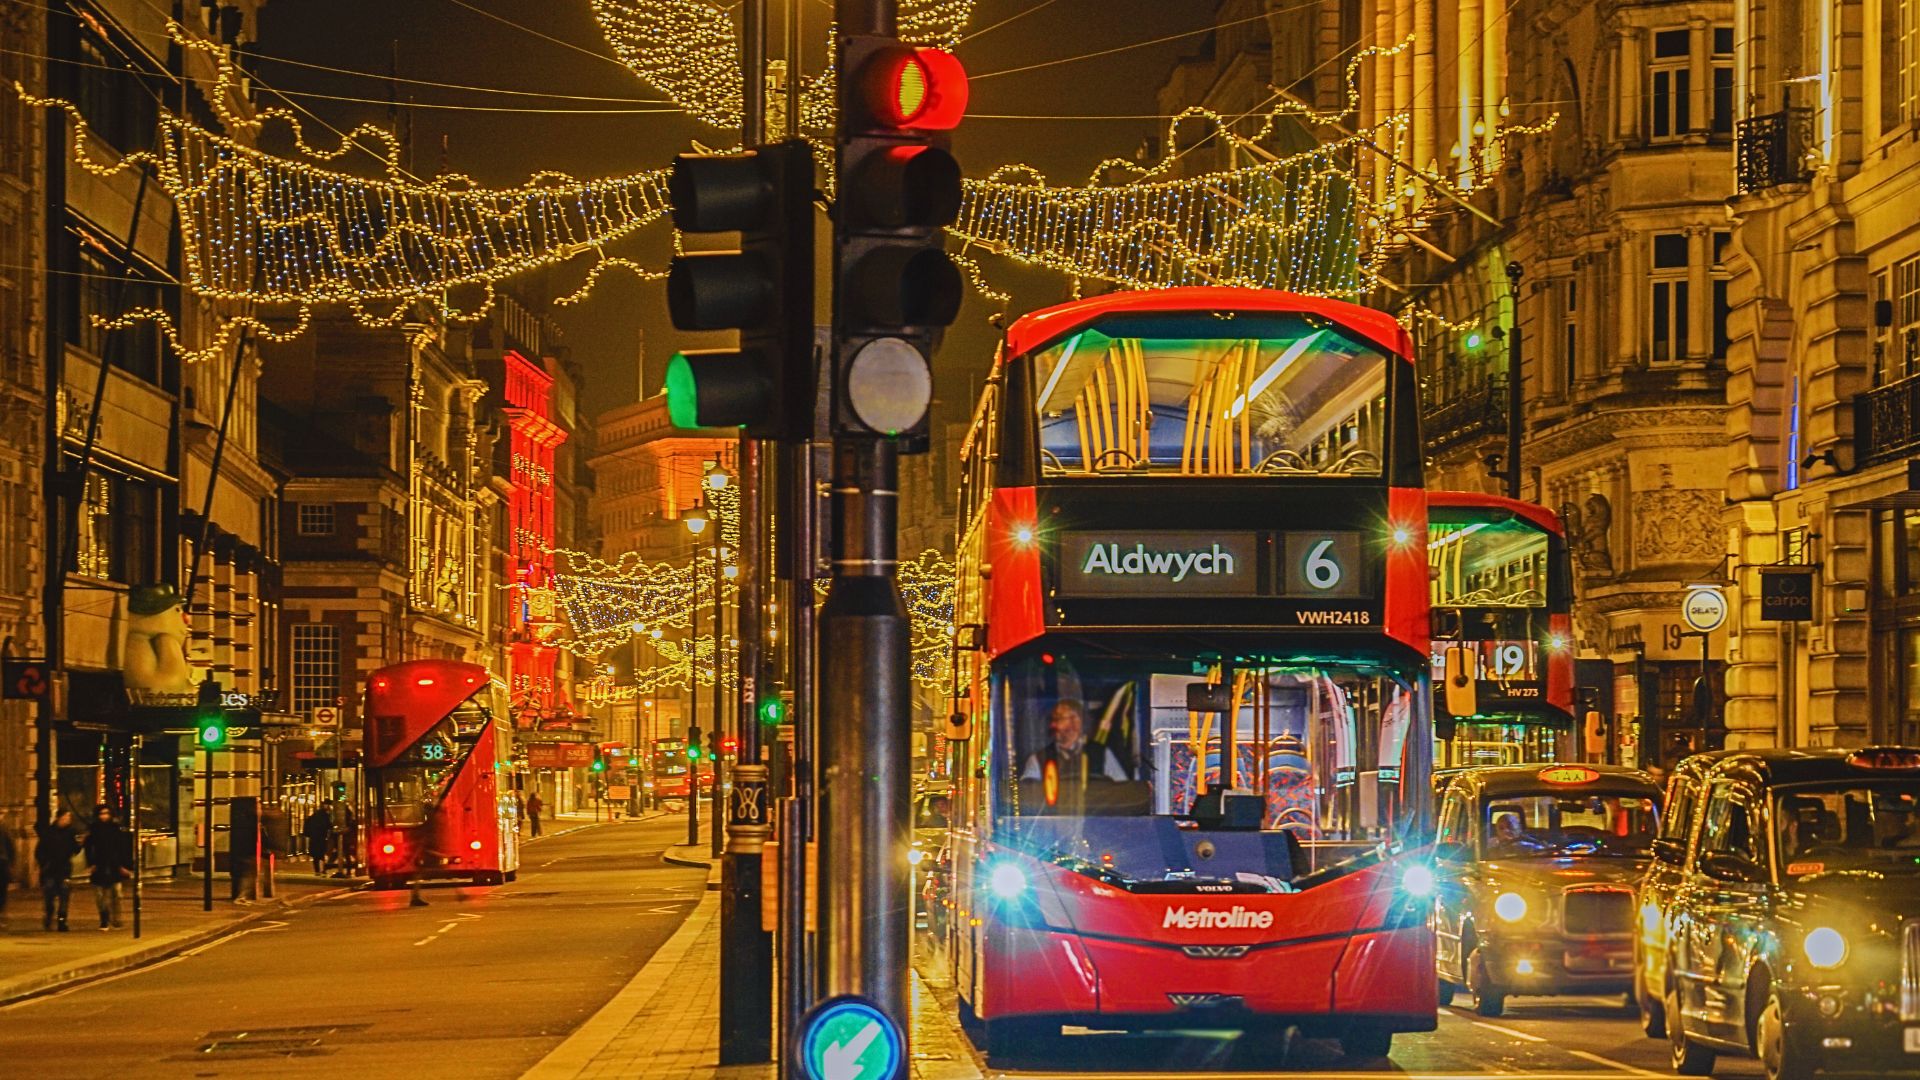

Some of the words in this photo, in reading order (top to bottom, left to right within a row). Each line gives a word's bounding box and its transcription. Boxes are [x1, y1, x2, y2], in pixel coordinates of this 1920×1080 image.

[1083, 543, 1234, 582] Aldwych
[1306, 540, 1340, 589] 6
[1296, 611, 1370, 624] VWH2418
[1691, 606, 1718, 614] GELATO
[1663, 624, 1682, 650] 19
[1495, 645, 1524, 675] 19
[1507, 688, 1521, 697] HV
[1523, 688, 1539, 697] 273
[423, 745, 444, 760] 38
[1162, 906, 1274, 929] Metroline
